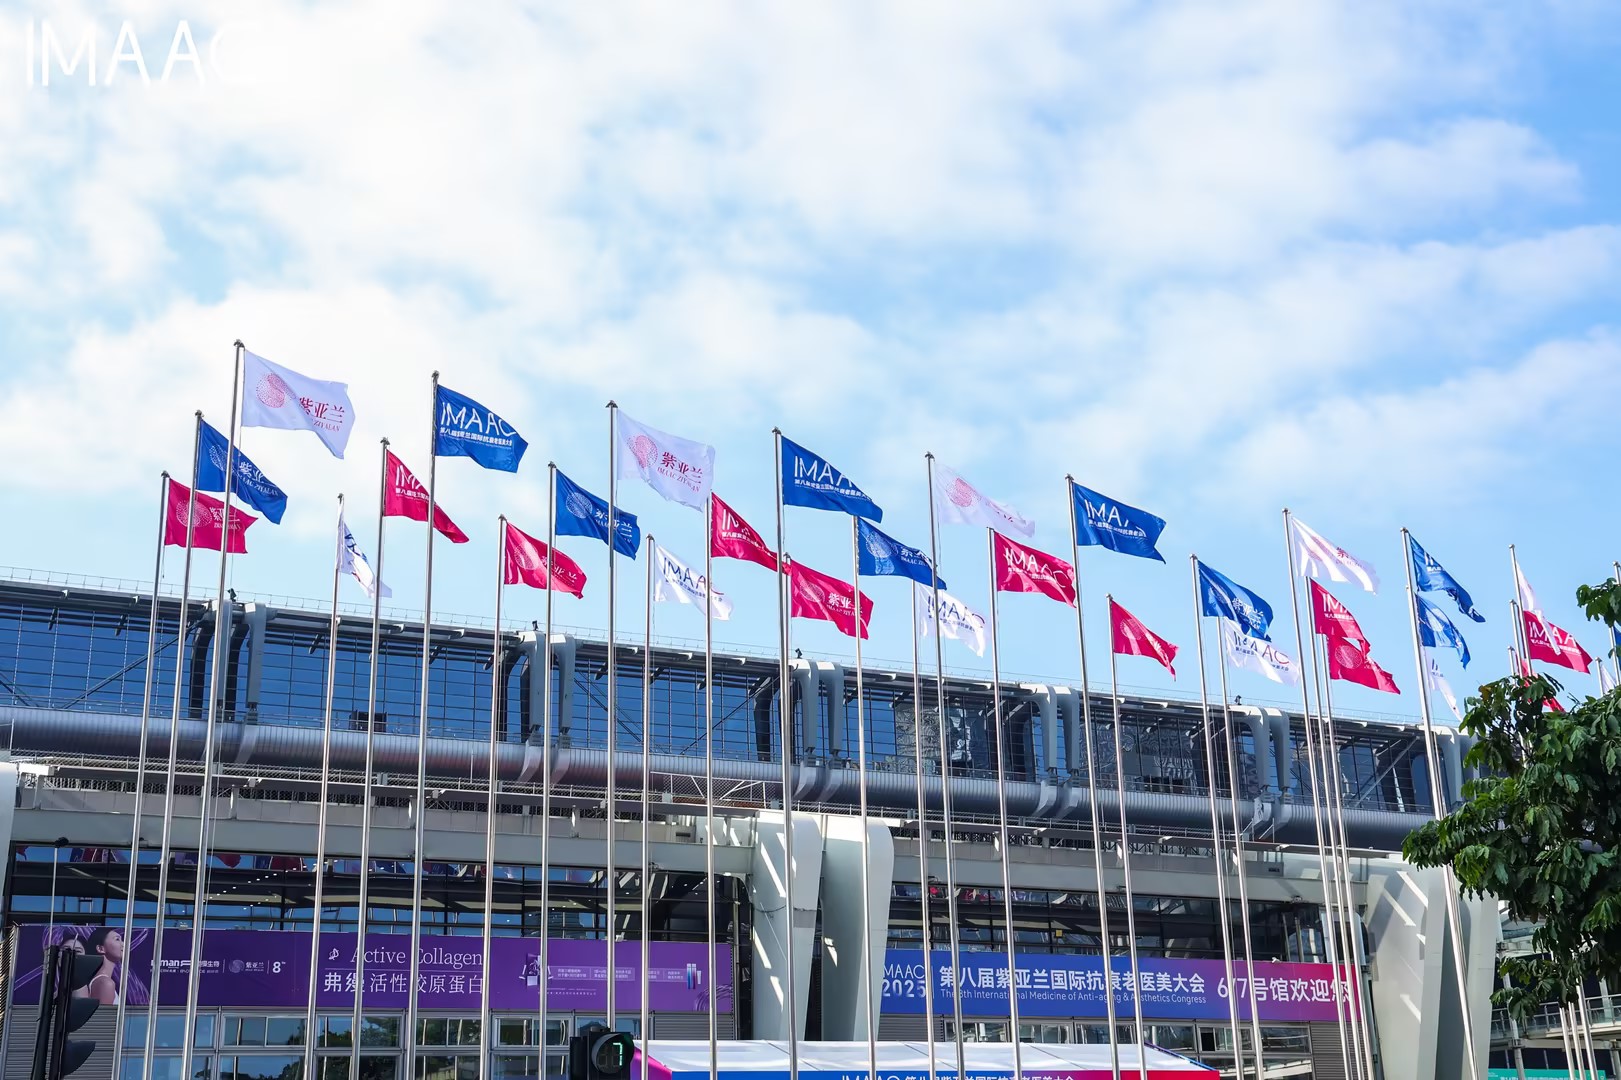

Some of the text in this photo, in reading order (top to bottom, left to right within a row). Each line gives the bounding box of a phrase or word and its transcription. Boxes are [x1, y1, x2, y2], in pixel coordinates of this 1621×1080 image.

[299, 397, 345, 424] 紫亚兰
[440, 402, 517, 437] IMAAC
[661, 451, 704, 485] 紫亚兰
[350, 946, 483, 969] Active Collagen
[882, 979, 926, 998] 2025
[940, 988, 955, 998] The
[974, 990, 1028, 1000] Internatinal
[1029, 991, 1067, 1001] Medicine
[1068, 992, 1077, 1001] of
[1078, 993, 1122, 1004] Anti-agng
[1123, 993, 1130, 1002] &
[1130, 993, 1170, 1003] Asthetics
[1171, 994, 1207, 1005] Congress
[613, 1042, 623, 1066] 7
